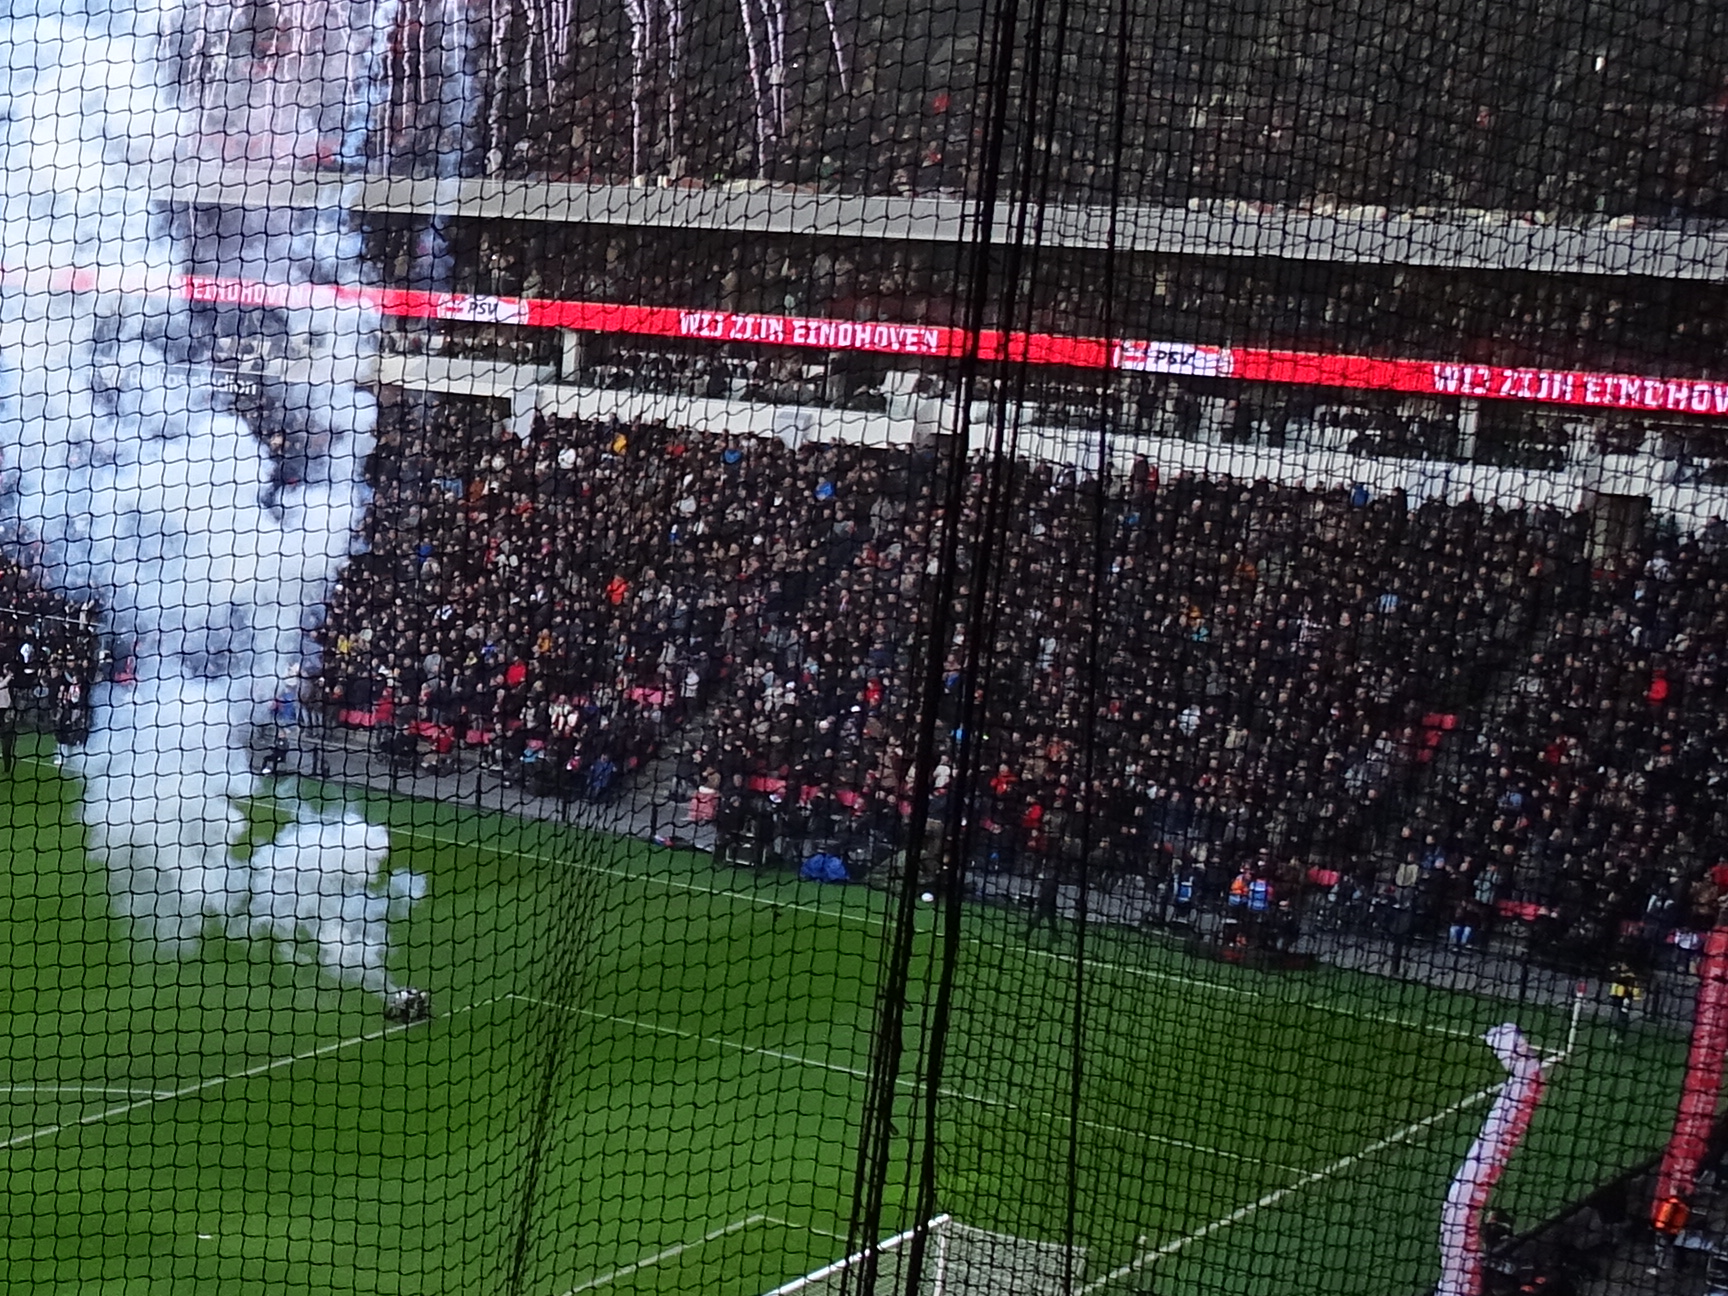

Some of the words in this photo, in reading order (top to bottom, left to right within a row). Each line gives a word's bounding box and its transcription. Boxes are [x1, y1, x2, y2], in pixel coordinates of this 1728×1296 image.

[468, 301, 497, 315] PSV
[680, 311, 724, 338] WIJ
[730, 312, 784, 343] ZIJN
[792, 318, 939, 354] EINDHOVEN
[1433, 364, 1491, 396] WIJ
[1498, 368, 1574, 402] ZIJN
